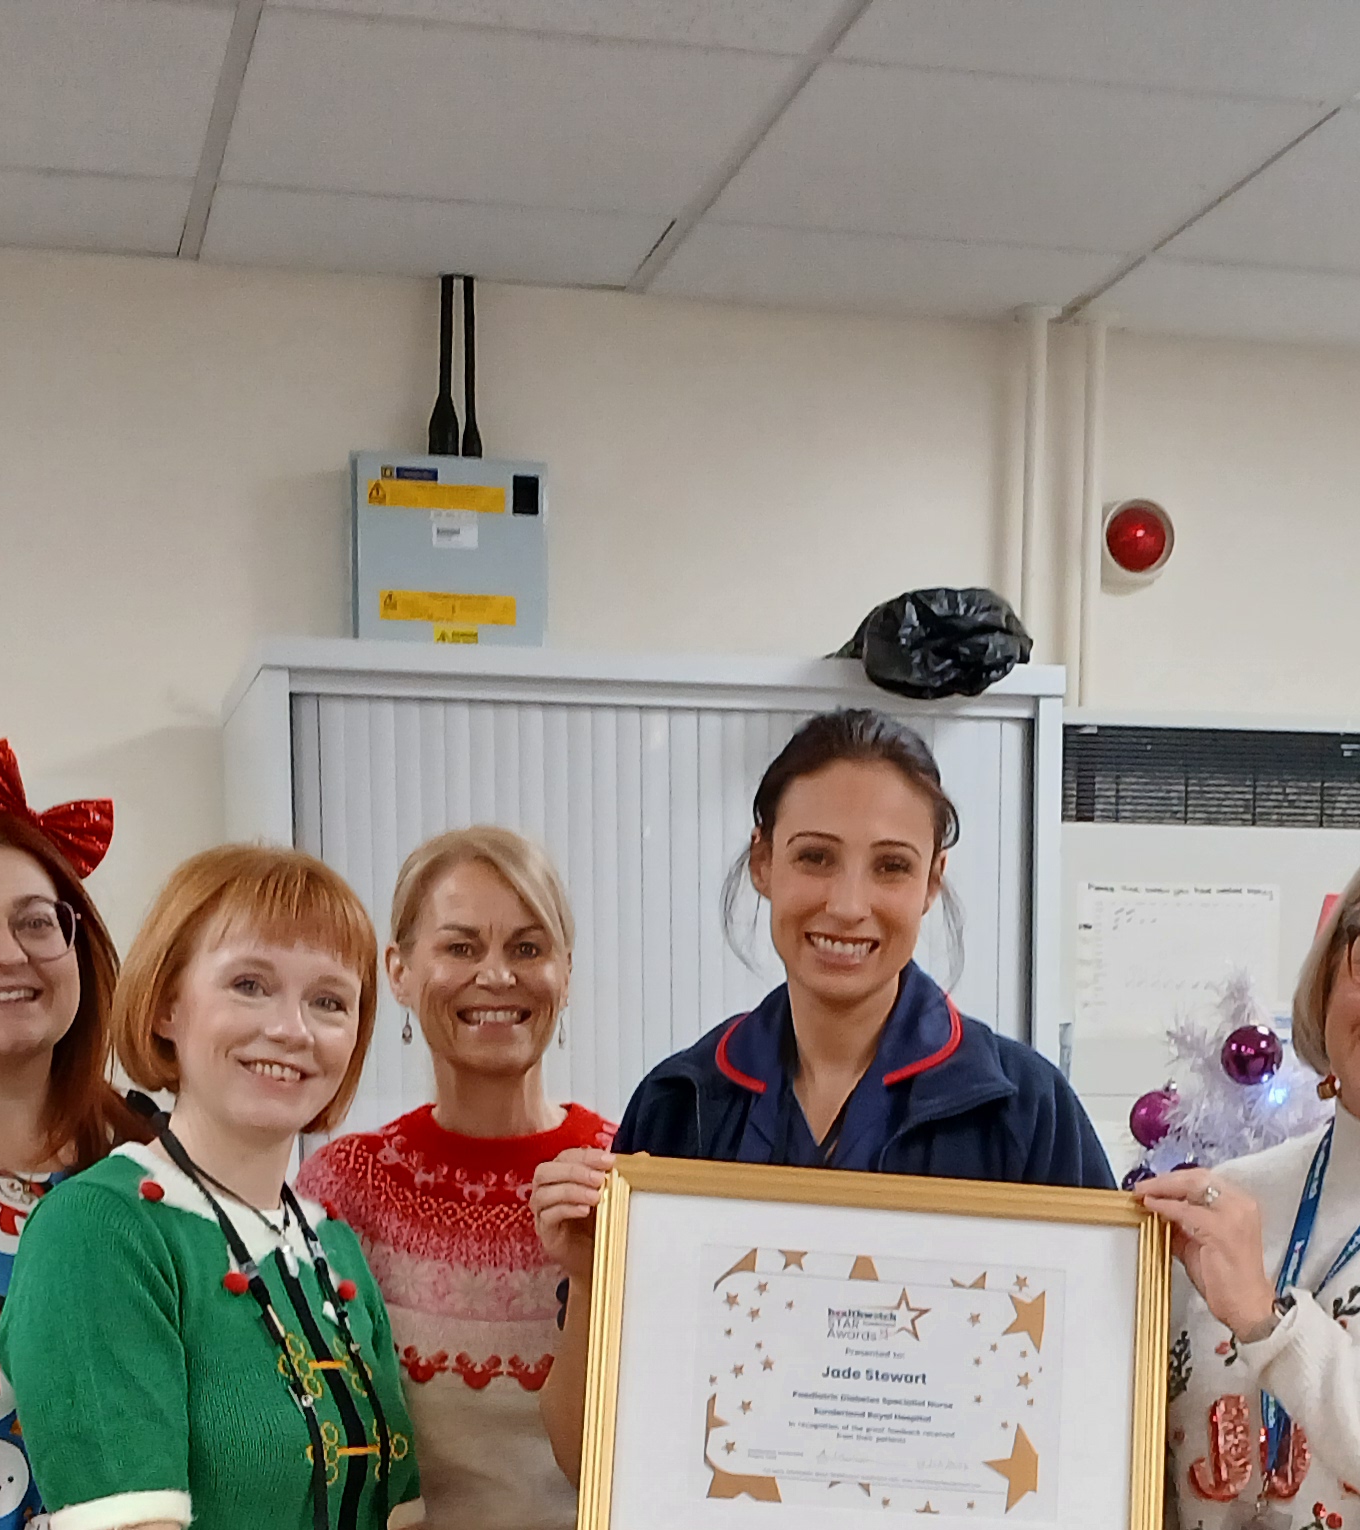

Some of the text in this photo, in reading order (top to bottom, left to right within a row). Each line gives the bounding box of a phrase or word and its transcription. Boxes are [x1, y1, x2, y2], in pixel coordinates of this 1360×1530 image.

[827, 1329, 877, 1342] Awards
[822, 1366, 927, 1385] Jade Stewart
